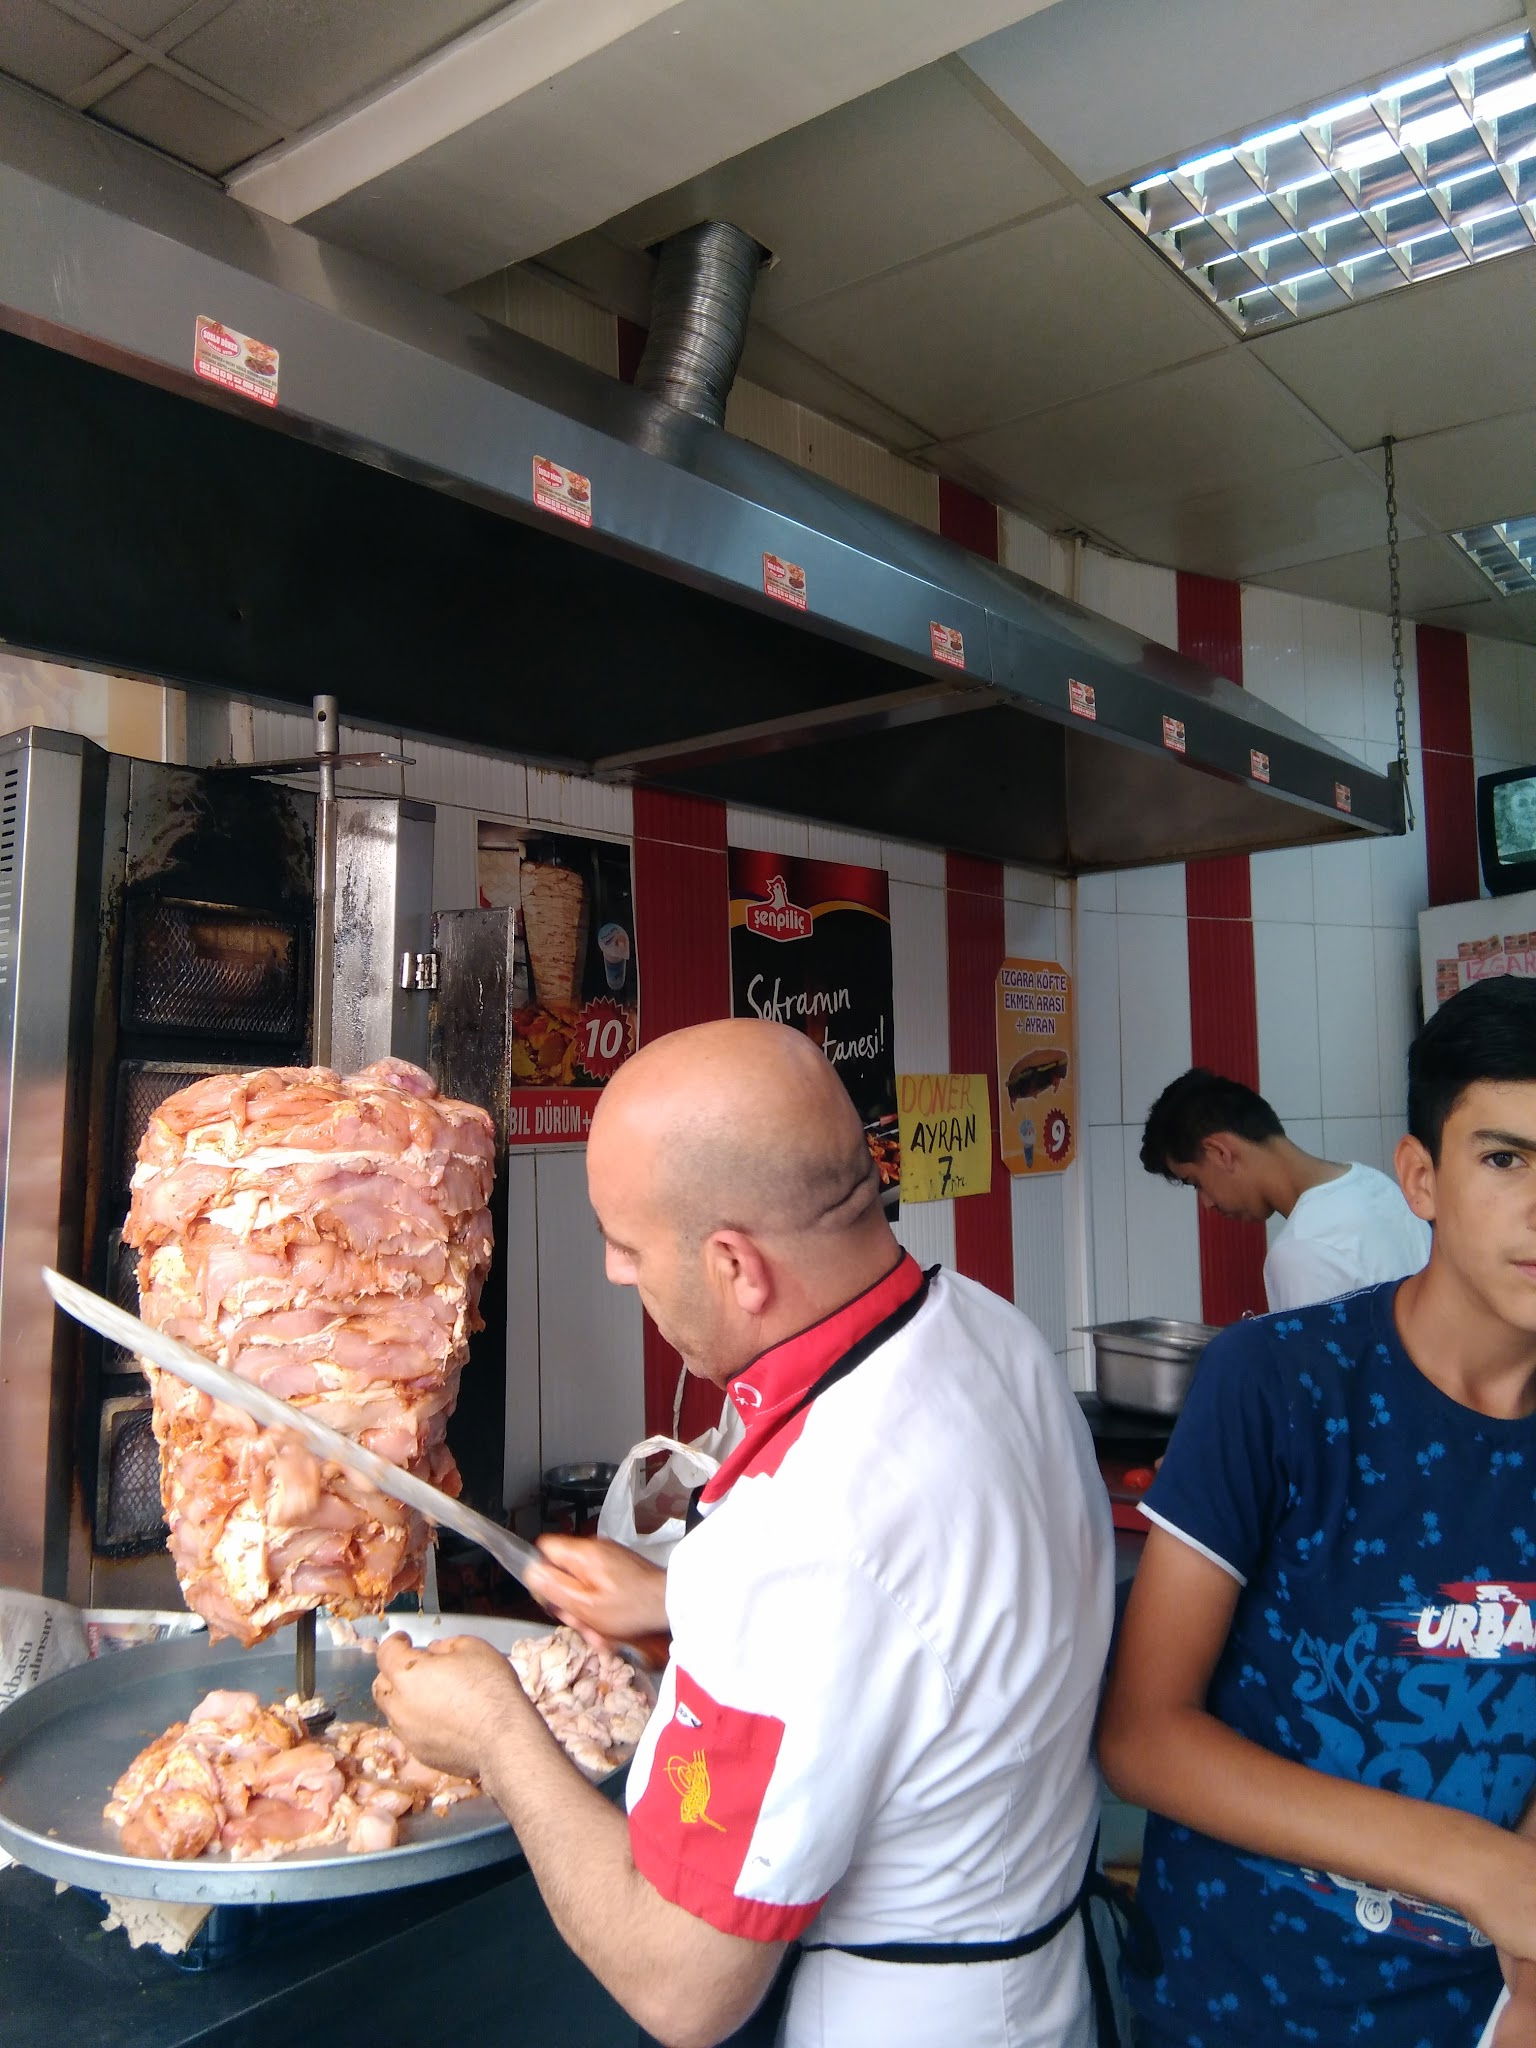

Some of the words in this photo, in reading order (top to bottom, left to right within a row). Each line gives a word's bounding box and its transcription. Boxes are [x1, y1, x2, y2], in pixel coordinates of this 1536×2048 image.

[754, 909, 805, 935] şenpiliç
[1001, 969, 1034, 988] IZGARA
[1036, 970, 1067, 991] KÖFTE
[1005, 993, 1035, 1010] EKMEK
[1036, 996, 1065, 1012] ARASI
[1025, 1017, 1055, 1034] AYRAN
[910, 1114, 976, 1154] AYRAN
[1052, 1119, 1066, 1153] 9
[1409, 1585, 1536, 1659] URBA
